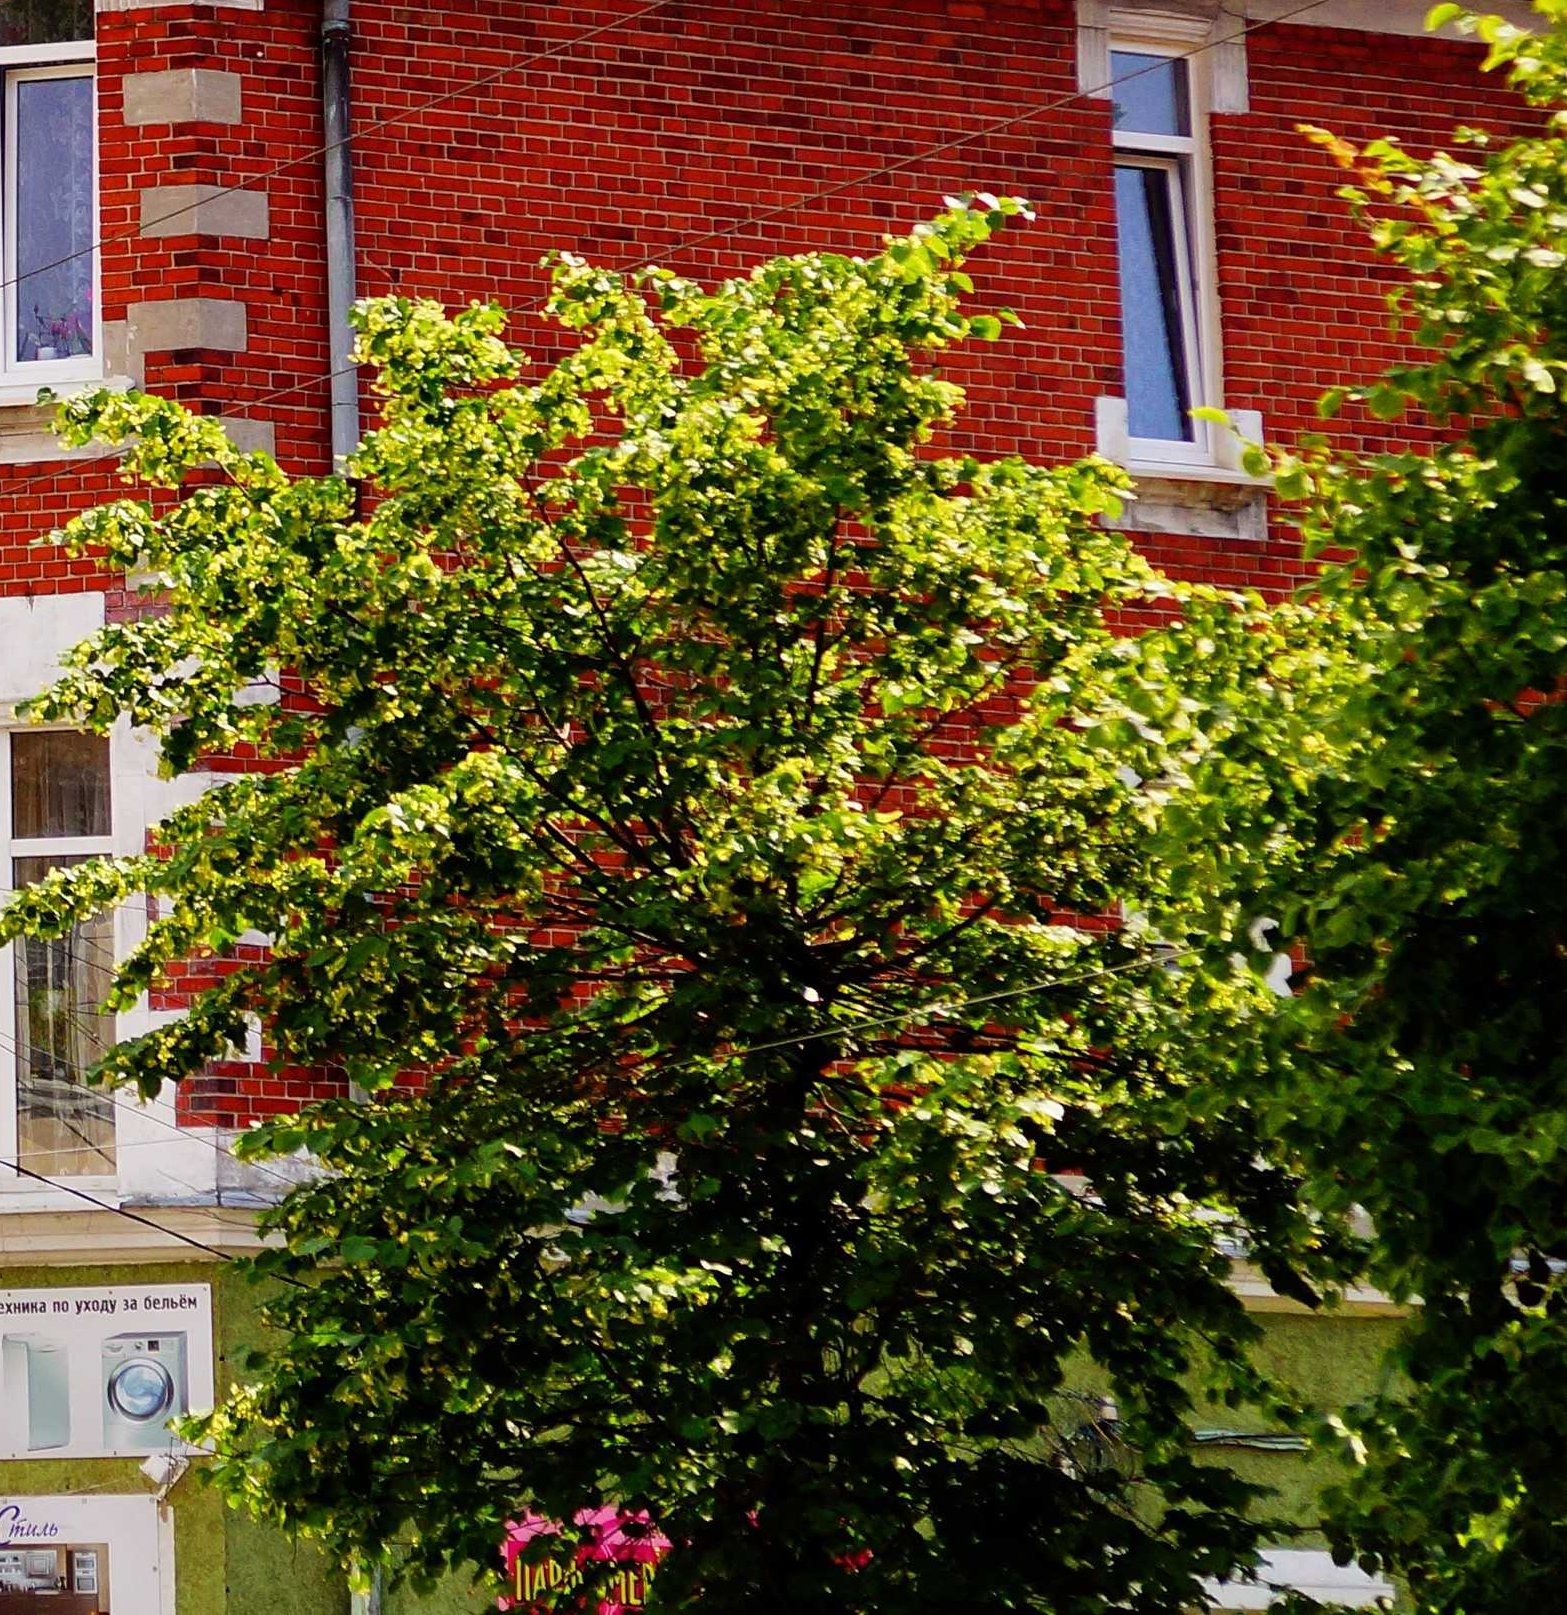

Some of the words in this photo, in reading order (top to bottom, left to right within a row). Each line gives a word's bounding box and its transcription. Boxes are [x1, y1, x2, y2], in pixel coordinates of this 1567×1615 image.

[52, 1300, 69, 1313] по
[75, 1299, 117, 1315] уходу
[123, 1298, 138, 1311] за
[143, 1294, 197, 1310] бельём
